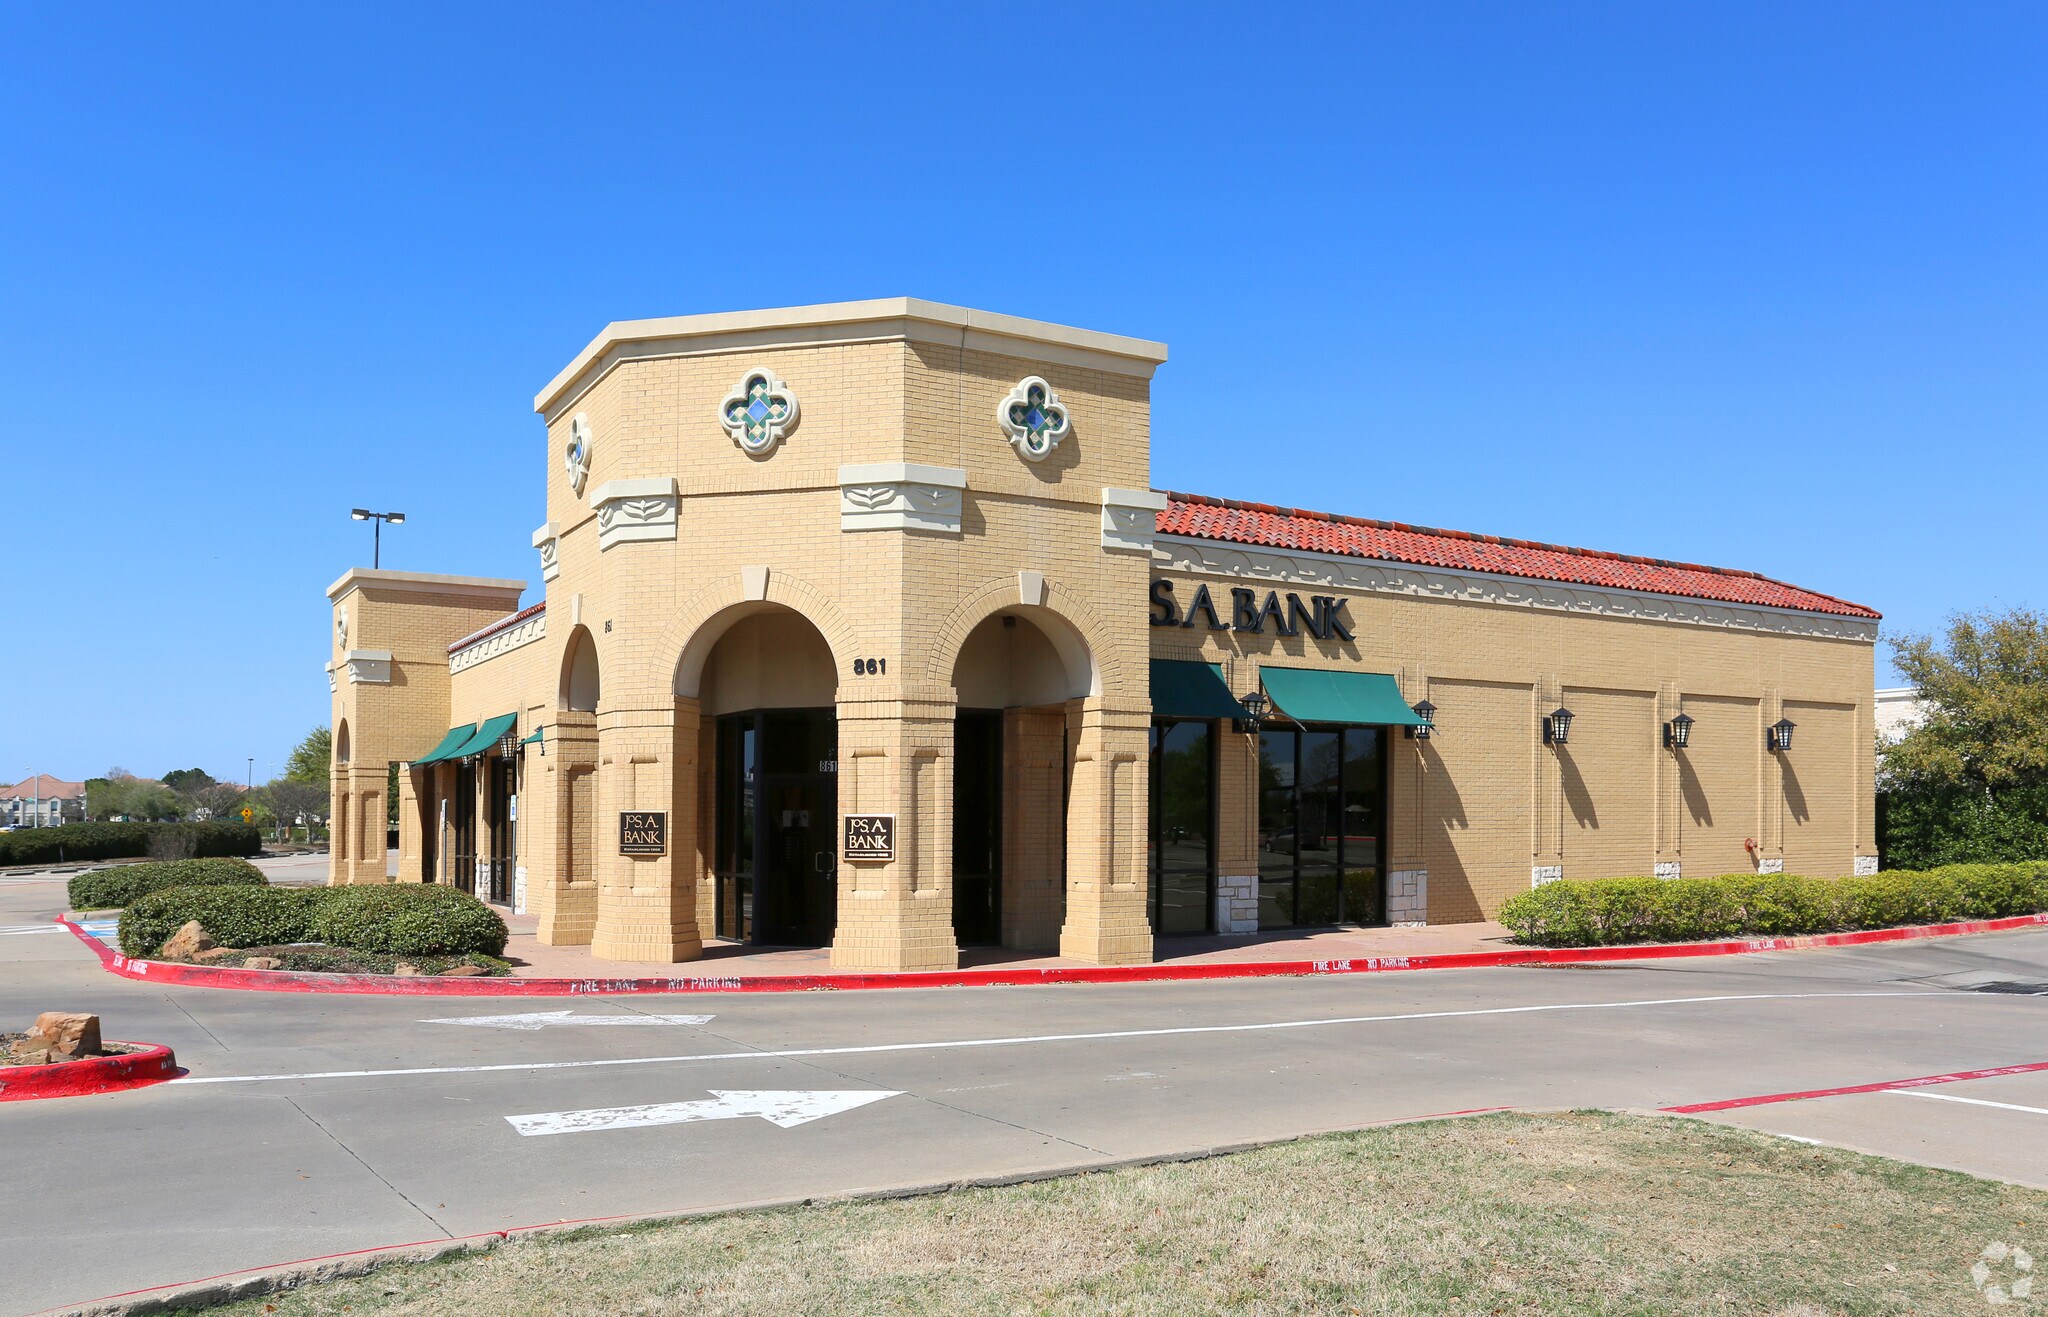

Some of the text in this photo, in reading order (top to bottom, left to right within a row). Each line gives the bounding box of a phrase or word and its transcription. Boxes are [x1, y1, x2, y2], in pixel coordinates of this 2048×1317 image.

[853, 658, 886, 676] 861
[820, 760, 838, 772] 861
[644, 815, 659, 828] A.
[870, 819, 887, 833] A.
[623, 830, 661, 844] BANK
[848, 835, 889, 849] BANK
[1313, 957, 1410, 971] FIRE LANE NO PARKING
[570, 980, 600, 993] FIRE
[691, 976, 741, 989] PARKING
